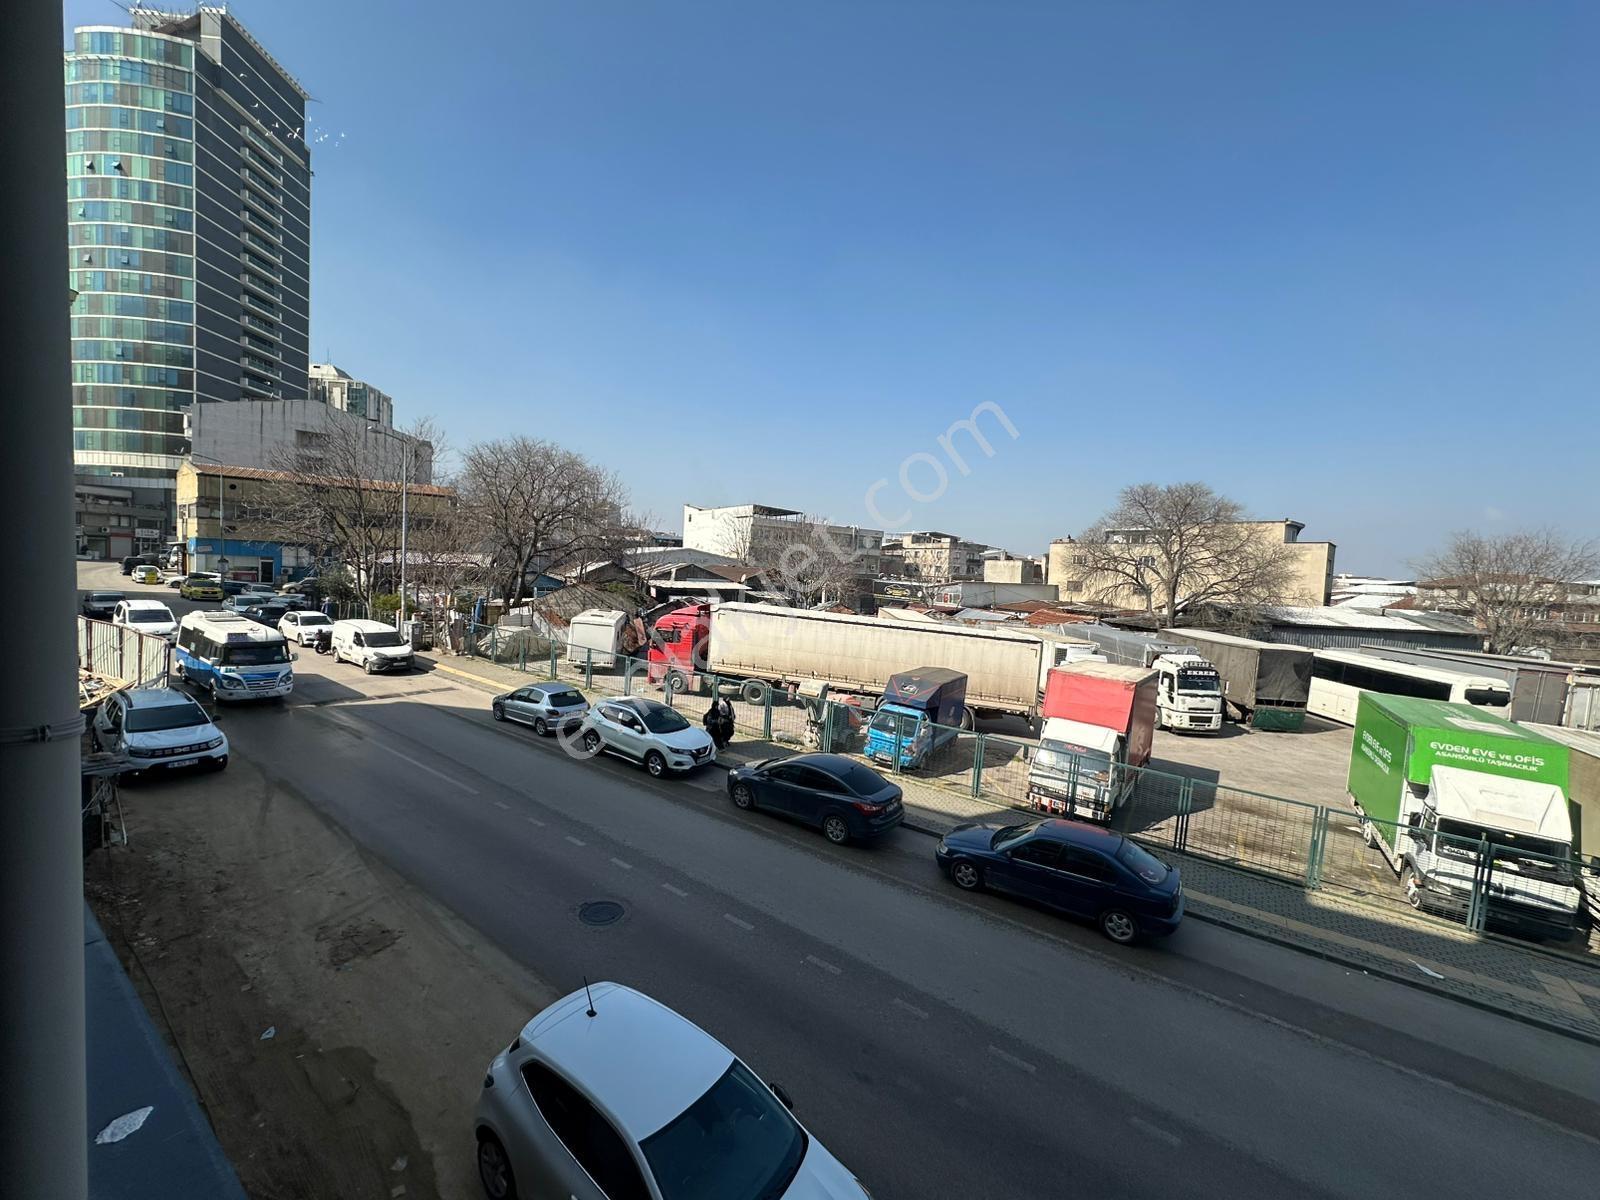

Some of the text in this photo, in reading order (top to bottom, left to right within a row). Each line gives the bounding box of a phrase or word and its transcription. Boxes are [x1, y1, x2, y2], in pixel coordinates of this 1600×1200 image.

[1430, 741, 1545, 766] EVDEN EVE ve OFİS
